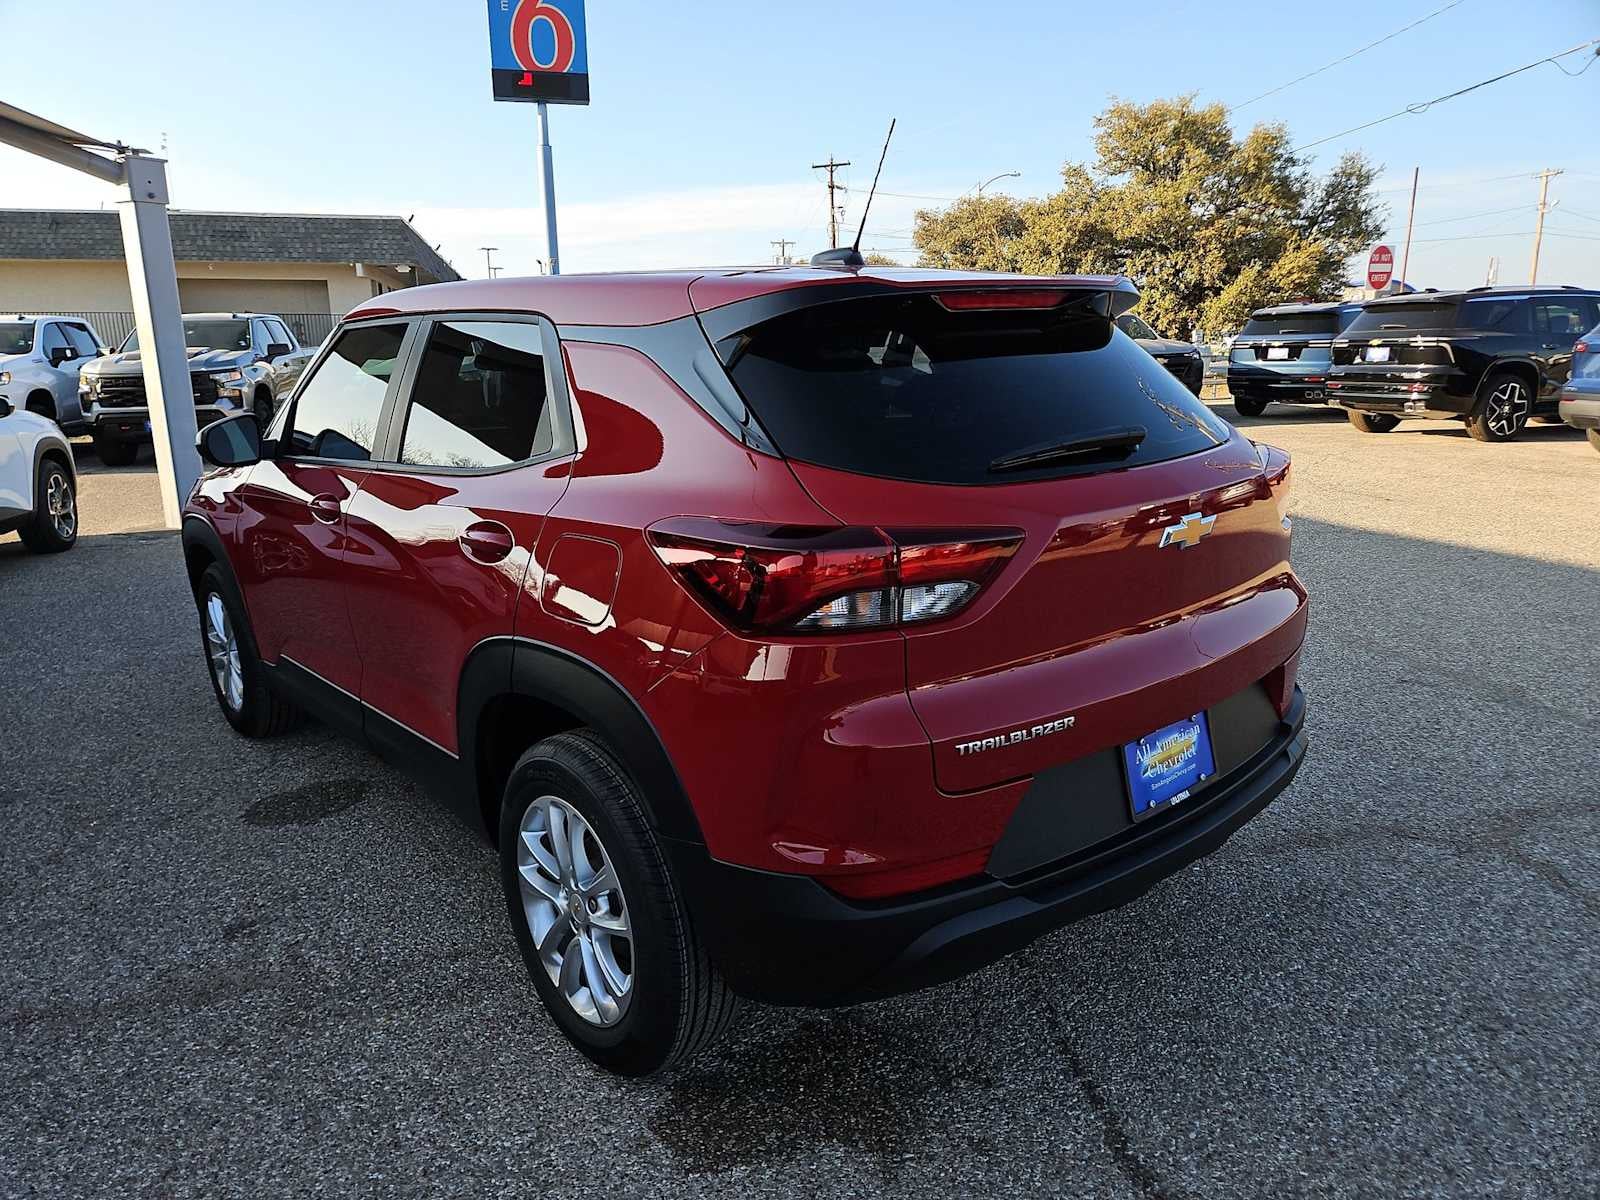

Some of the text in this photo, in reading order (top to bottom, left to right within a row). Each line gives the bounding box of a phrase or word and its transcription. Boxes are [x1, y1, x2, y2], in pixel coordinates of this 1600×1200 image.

[510, 0, 575, 72] 6
[1371, 253, 1391, 262] DO NOT
[1371, 273, 1388, 282] ENTER
[955, 716, 1075, 756] TRAILBLAZER
[1136, 724, 1201, 764] All American
[1142, 745, 1197, 778] Chevrolet
